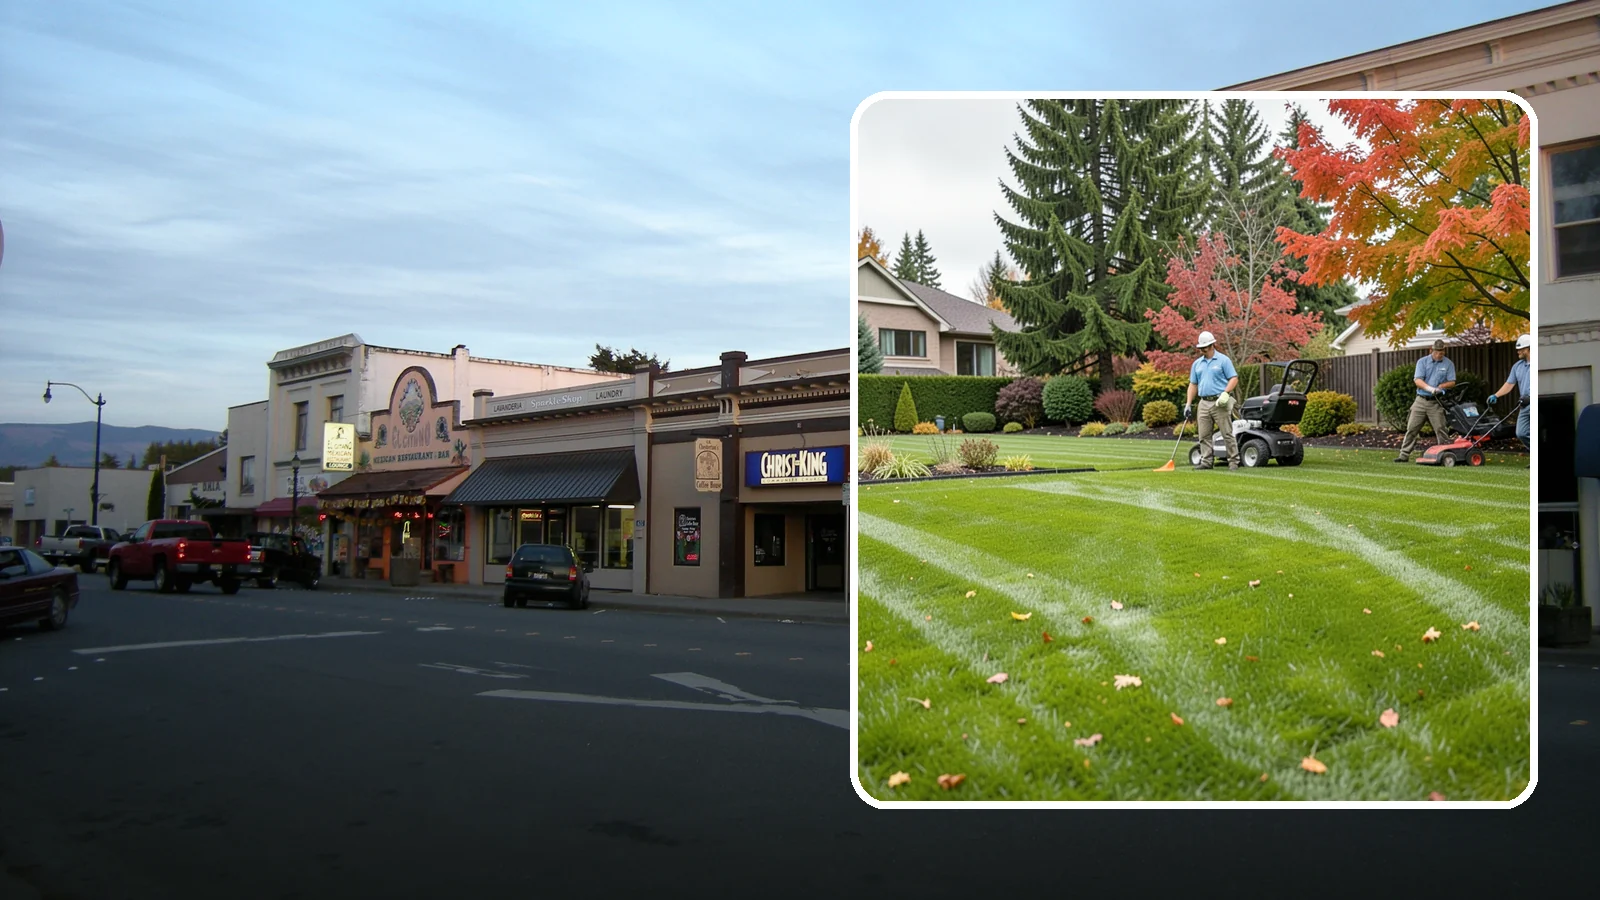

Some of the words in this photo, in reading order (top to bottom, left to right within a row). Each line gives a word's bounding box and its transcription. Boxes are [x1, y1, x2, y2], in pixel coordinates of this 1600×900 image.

[595, 389, 623, 400] LAUNDRY
[493, 402, 522, 412] LAVANDERIA
[531, 397, 560, 408] Sparkle
[562, 395, 582, 404] Shop
[373, 454, 396, 464] MEXICAN
[397, 451, 434, 462] RESTAURANT
[438, 450, 450, 459] BAR
[760, 452, 797, 478] CHRIST
[799, 450, 827, 476] KING
